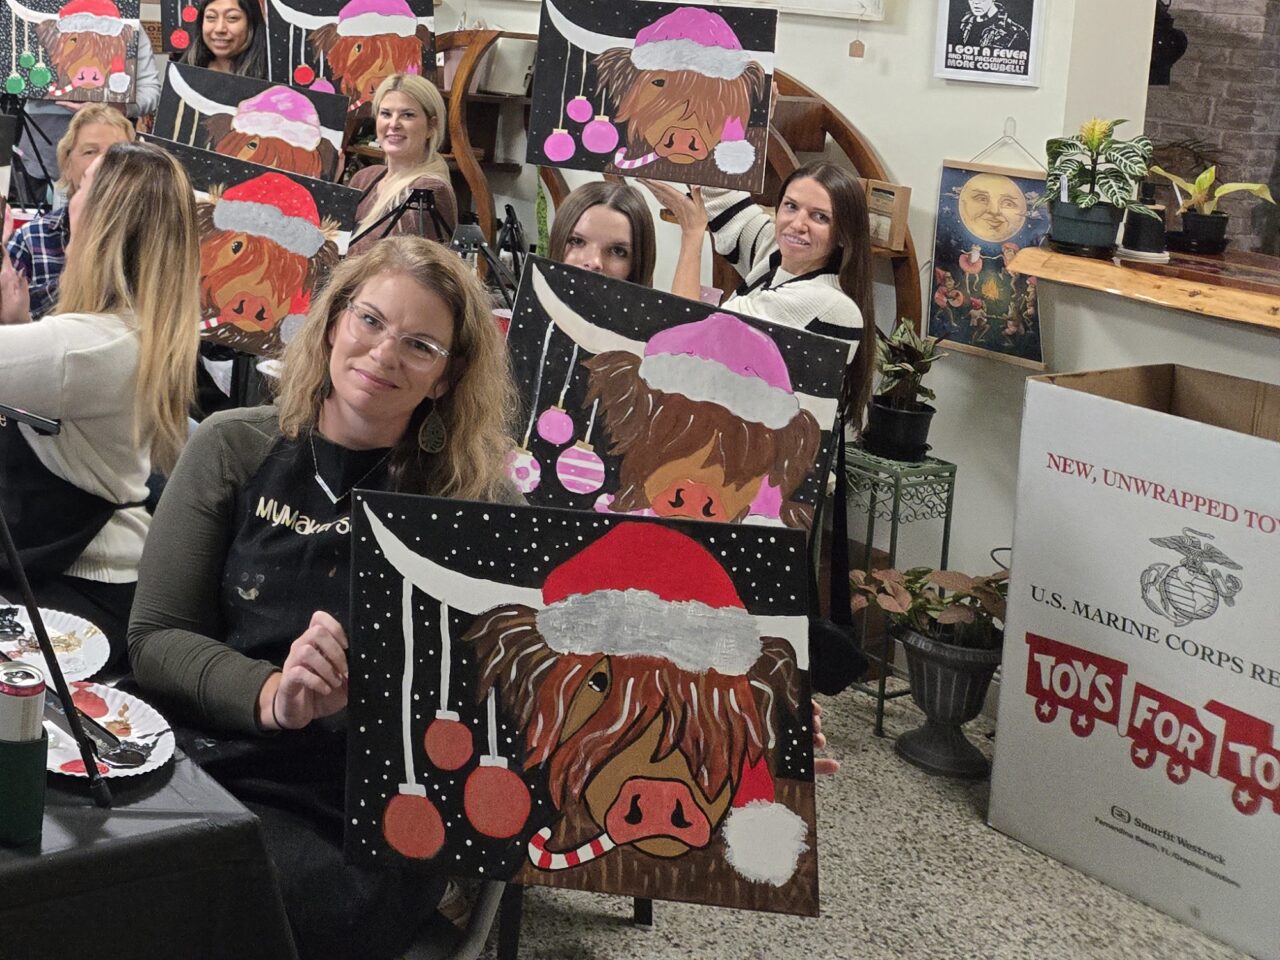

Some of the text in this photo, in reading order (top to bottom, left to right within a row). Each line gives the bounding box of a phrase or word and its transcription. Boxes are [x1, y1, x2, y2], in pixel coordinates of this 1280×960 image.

[947, 59, 1025, 74] MORE COWBELL!
[948, 44, 1028, 60] I GOT A FEVER
[975, 55, 1018, 65] PRESCRIPTION
[1046, 451, 1280, 535] NEW, UNWRAPPED TO
[1030, 584, 1067, 610] U.S.
[1071, 599, 1161, 644] MARINE
[1165, 633, 1244, 674] CORPS
[1033, 652, 1114, 713] TOYS
[1133, 694, 1204, 761] FOR
[1094, 816, 1134, 839] Fernandina
[1133, 817, 1226, 866] Smurfit Westrock
